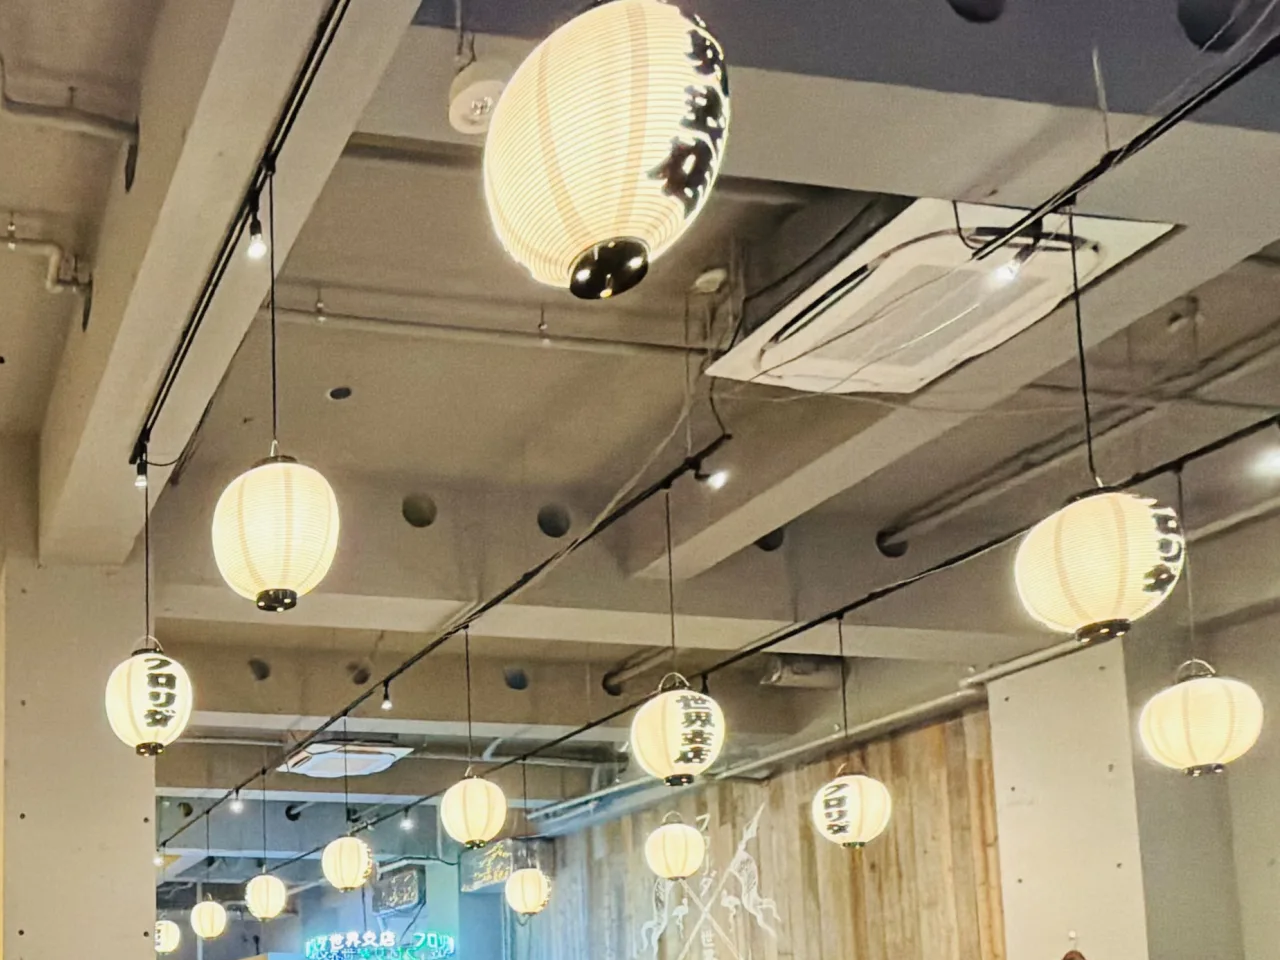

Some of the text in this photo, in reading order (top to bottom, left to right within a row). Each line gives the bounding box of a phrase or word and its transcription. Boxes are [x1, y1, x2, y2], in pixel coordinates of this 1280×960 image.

[144, 657, 177, 728] フロリダ
[823, 783, 850, 835] フロリダ
